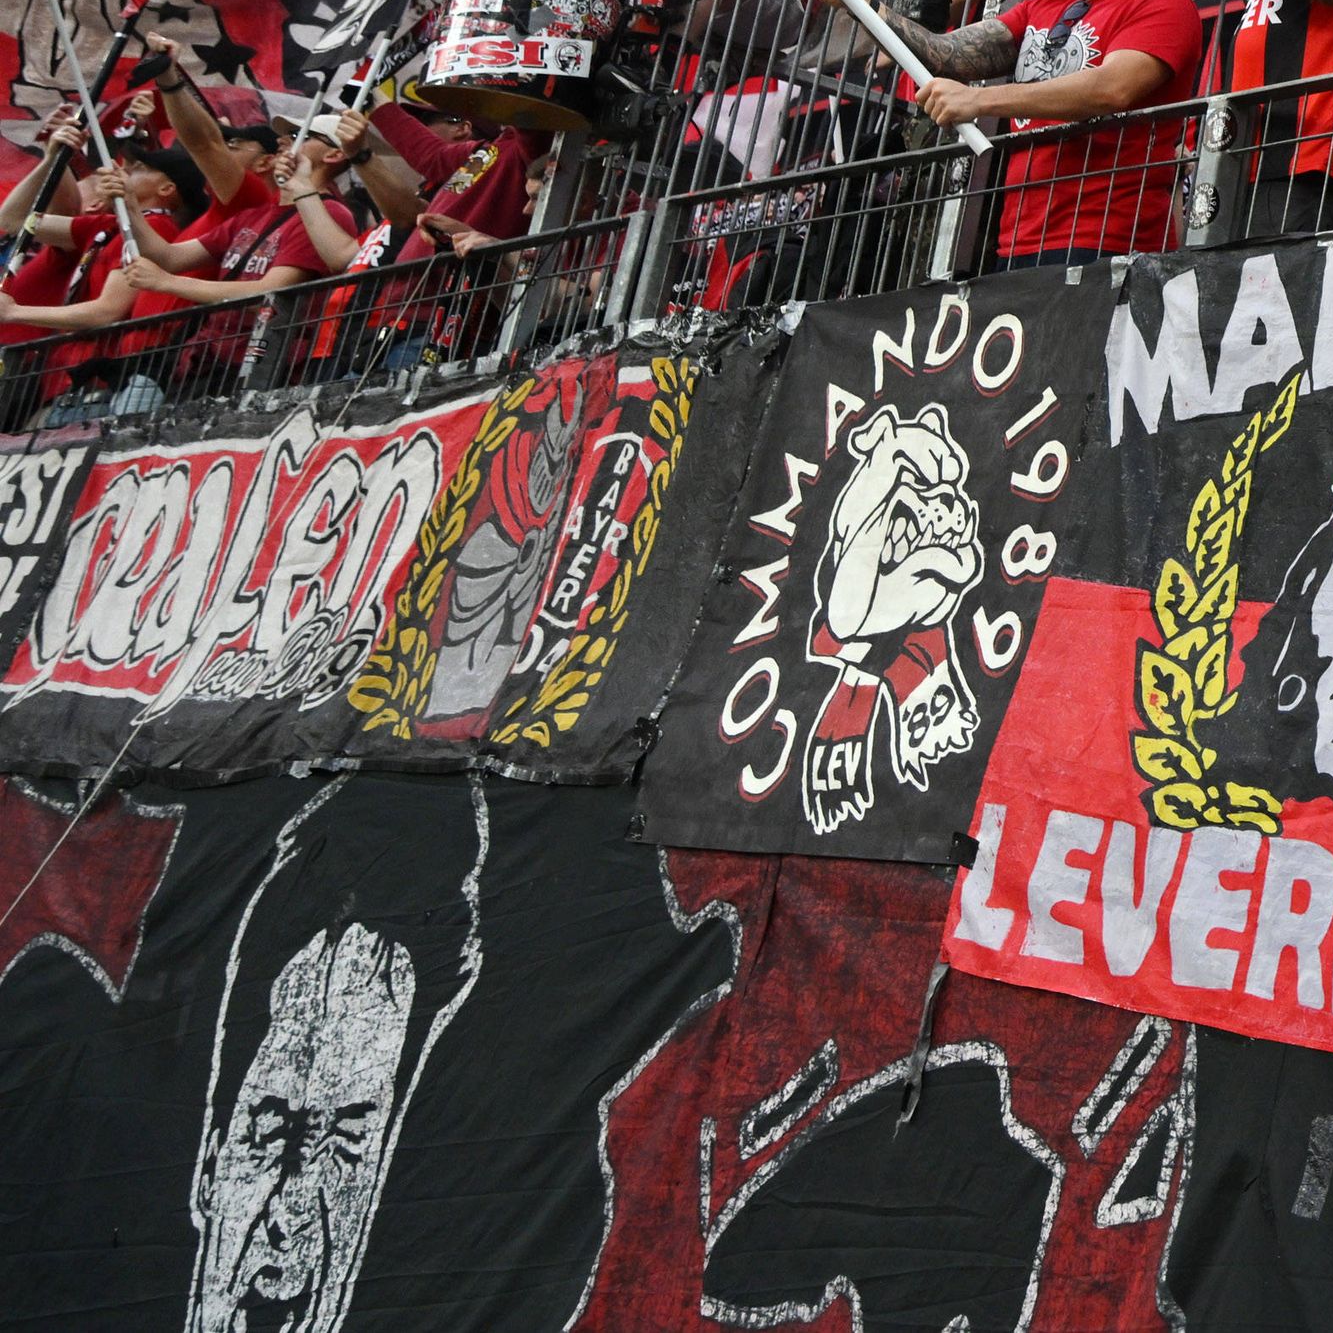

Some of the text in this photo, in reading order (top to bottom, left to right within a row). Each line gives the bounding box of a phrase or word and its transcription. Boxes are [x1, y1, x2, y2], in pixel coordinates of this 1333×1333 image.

[431, 39, 547, 76] FSI
[719, 293, 1025, 800] COMMANDO
[972, 386, 1068, 677] 1986
[813, 740, 862, 792] LEV
